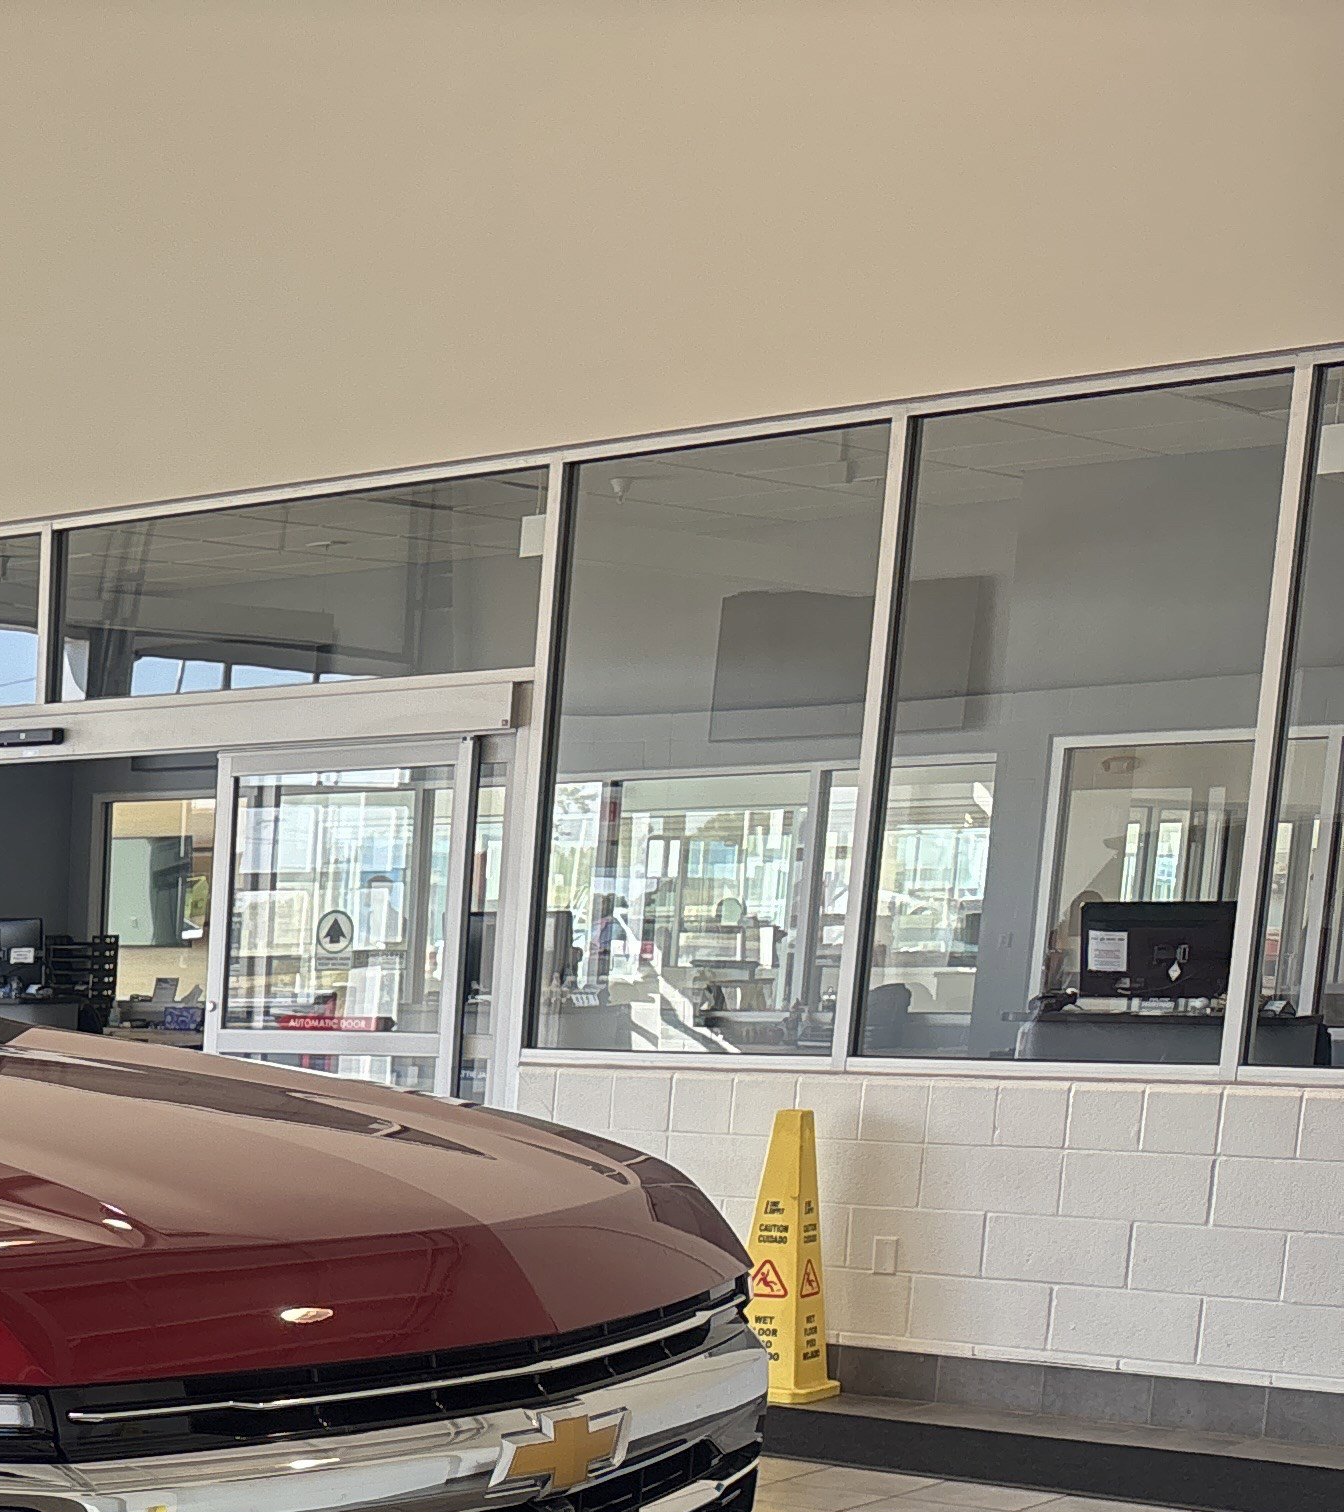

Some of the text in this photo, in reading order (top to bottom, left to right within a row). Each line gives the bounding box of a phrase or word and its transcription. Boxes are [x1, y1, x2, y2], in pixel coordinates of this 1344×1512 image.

[288, 1018, 366, 1029] AUTOMATIC DOOR
[759, 1223, 789, 1233] CAUTION
[754, 1315, 775, 1325] WET
[753, 1326, 778, 1337] OOR
